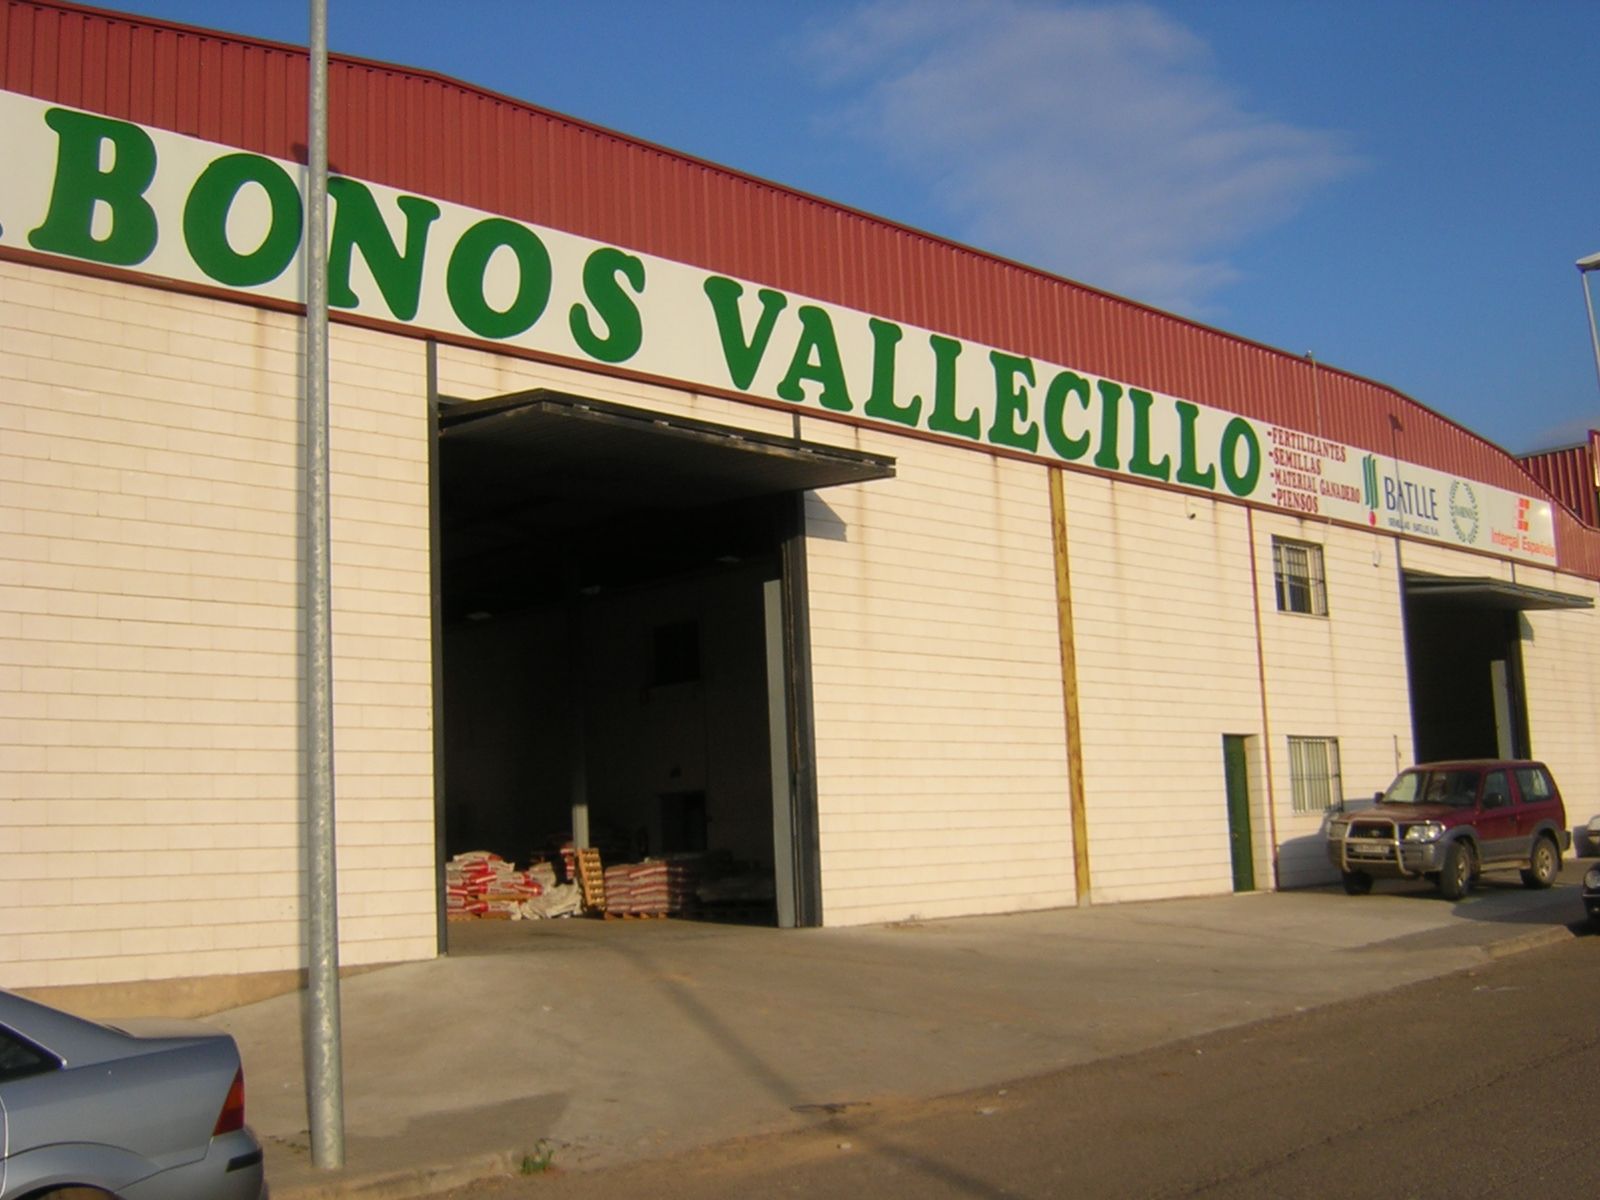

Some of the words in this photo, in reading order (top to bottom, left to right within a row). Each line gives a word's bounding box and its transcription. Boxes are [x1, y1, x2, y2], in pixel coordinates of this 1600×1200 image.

[0, 106, 645, 364] BONOS
[703, 275, 1261, 496] VALLECILLO
[1274, 447, 1321, 475] SEMILLAS
[1274, 468, 1317, 494] MATERIAL
[1320, 479, 1360, 504] GANADERO
[1276, 488, 1318, 513] PIENSOS
[1384, 476, 1439, 521] BATLLE
